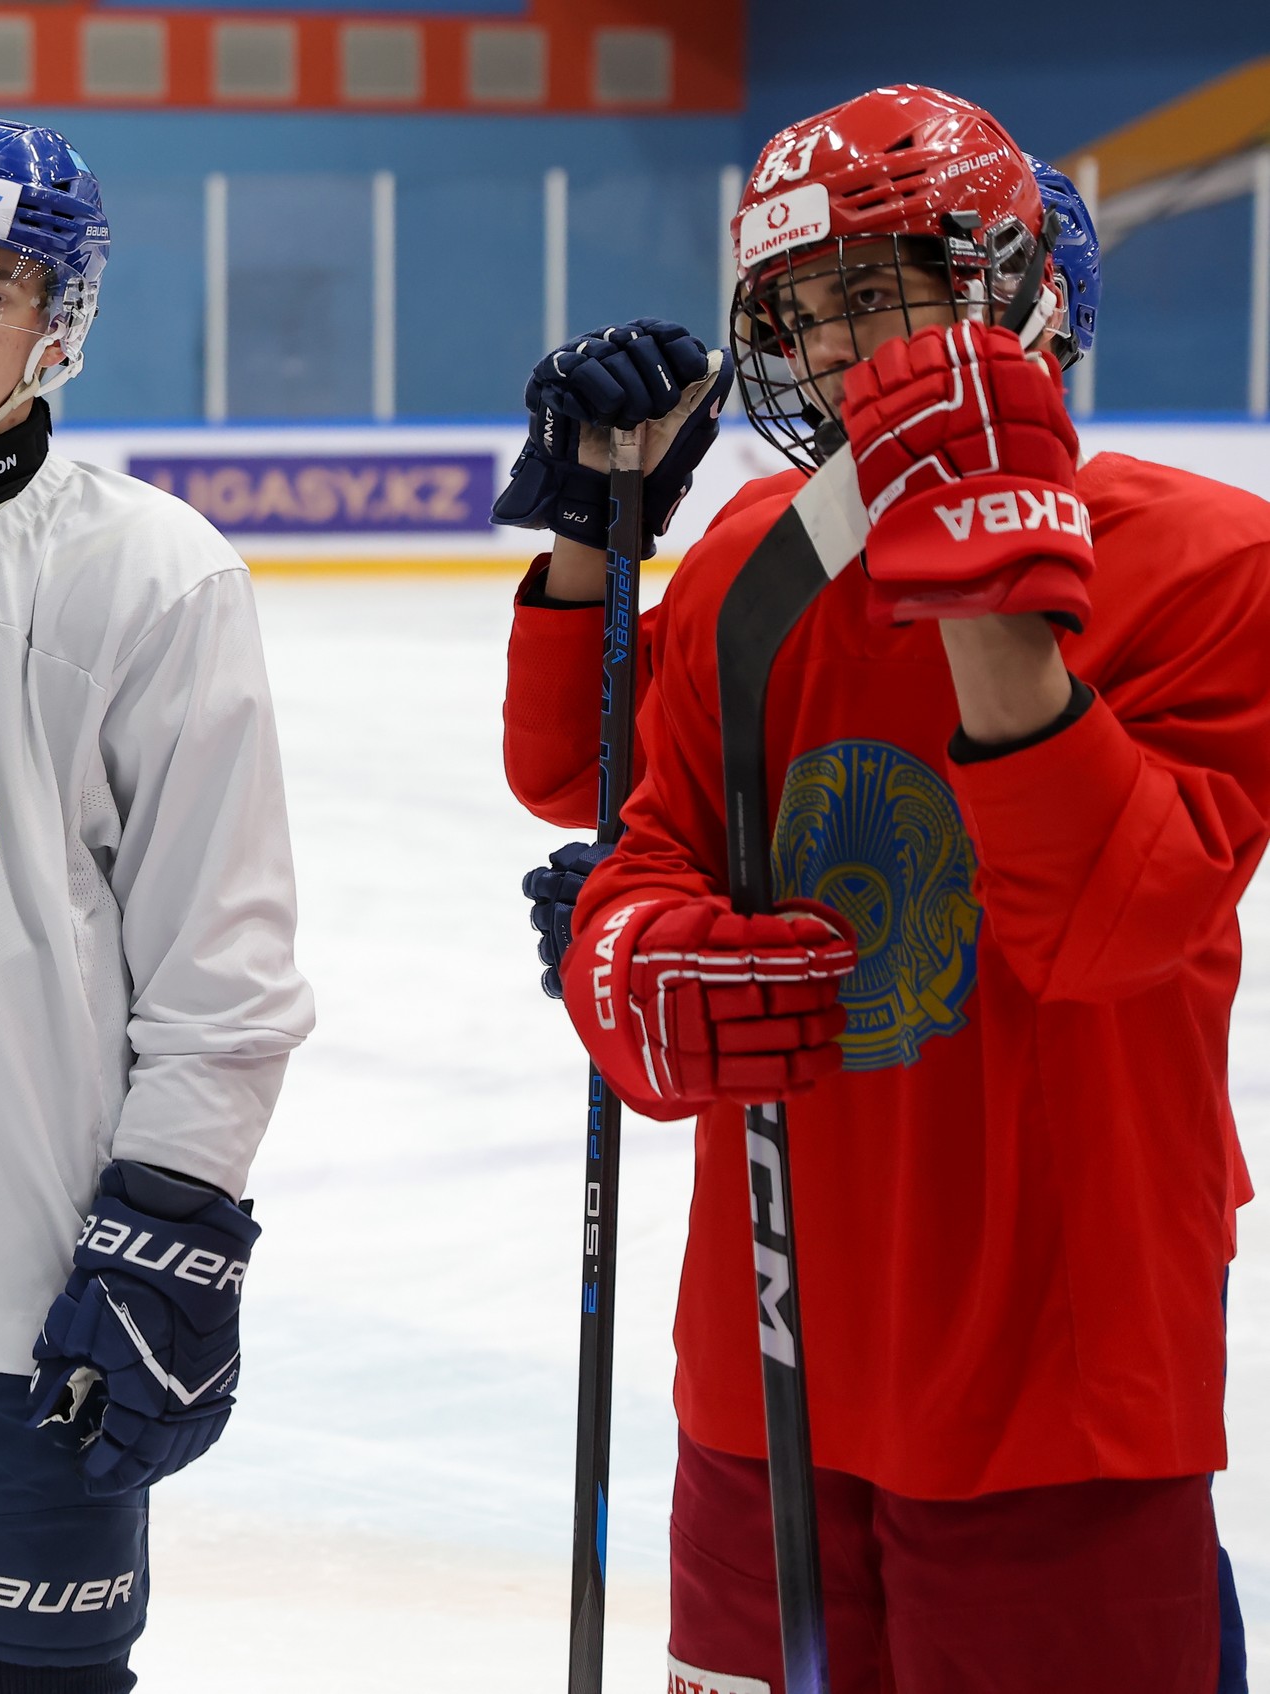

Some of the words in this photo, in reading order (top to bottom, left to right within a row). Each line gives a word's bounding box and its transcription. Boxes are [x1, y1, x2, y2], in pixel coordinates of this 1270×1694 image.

[756, 132, 821, 193] 83
[947, 152, 999, 178] BAUER
[86, 226, 109, 237] BAUER
[745, 222, 822, 260] OLIMPBET
[934, 490, 1093, 549] ОСКВА
[617, 556, 631, 646] BAUER
[76, 1214, 248, 1295] BAUER
